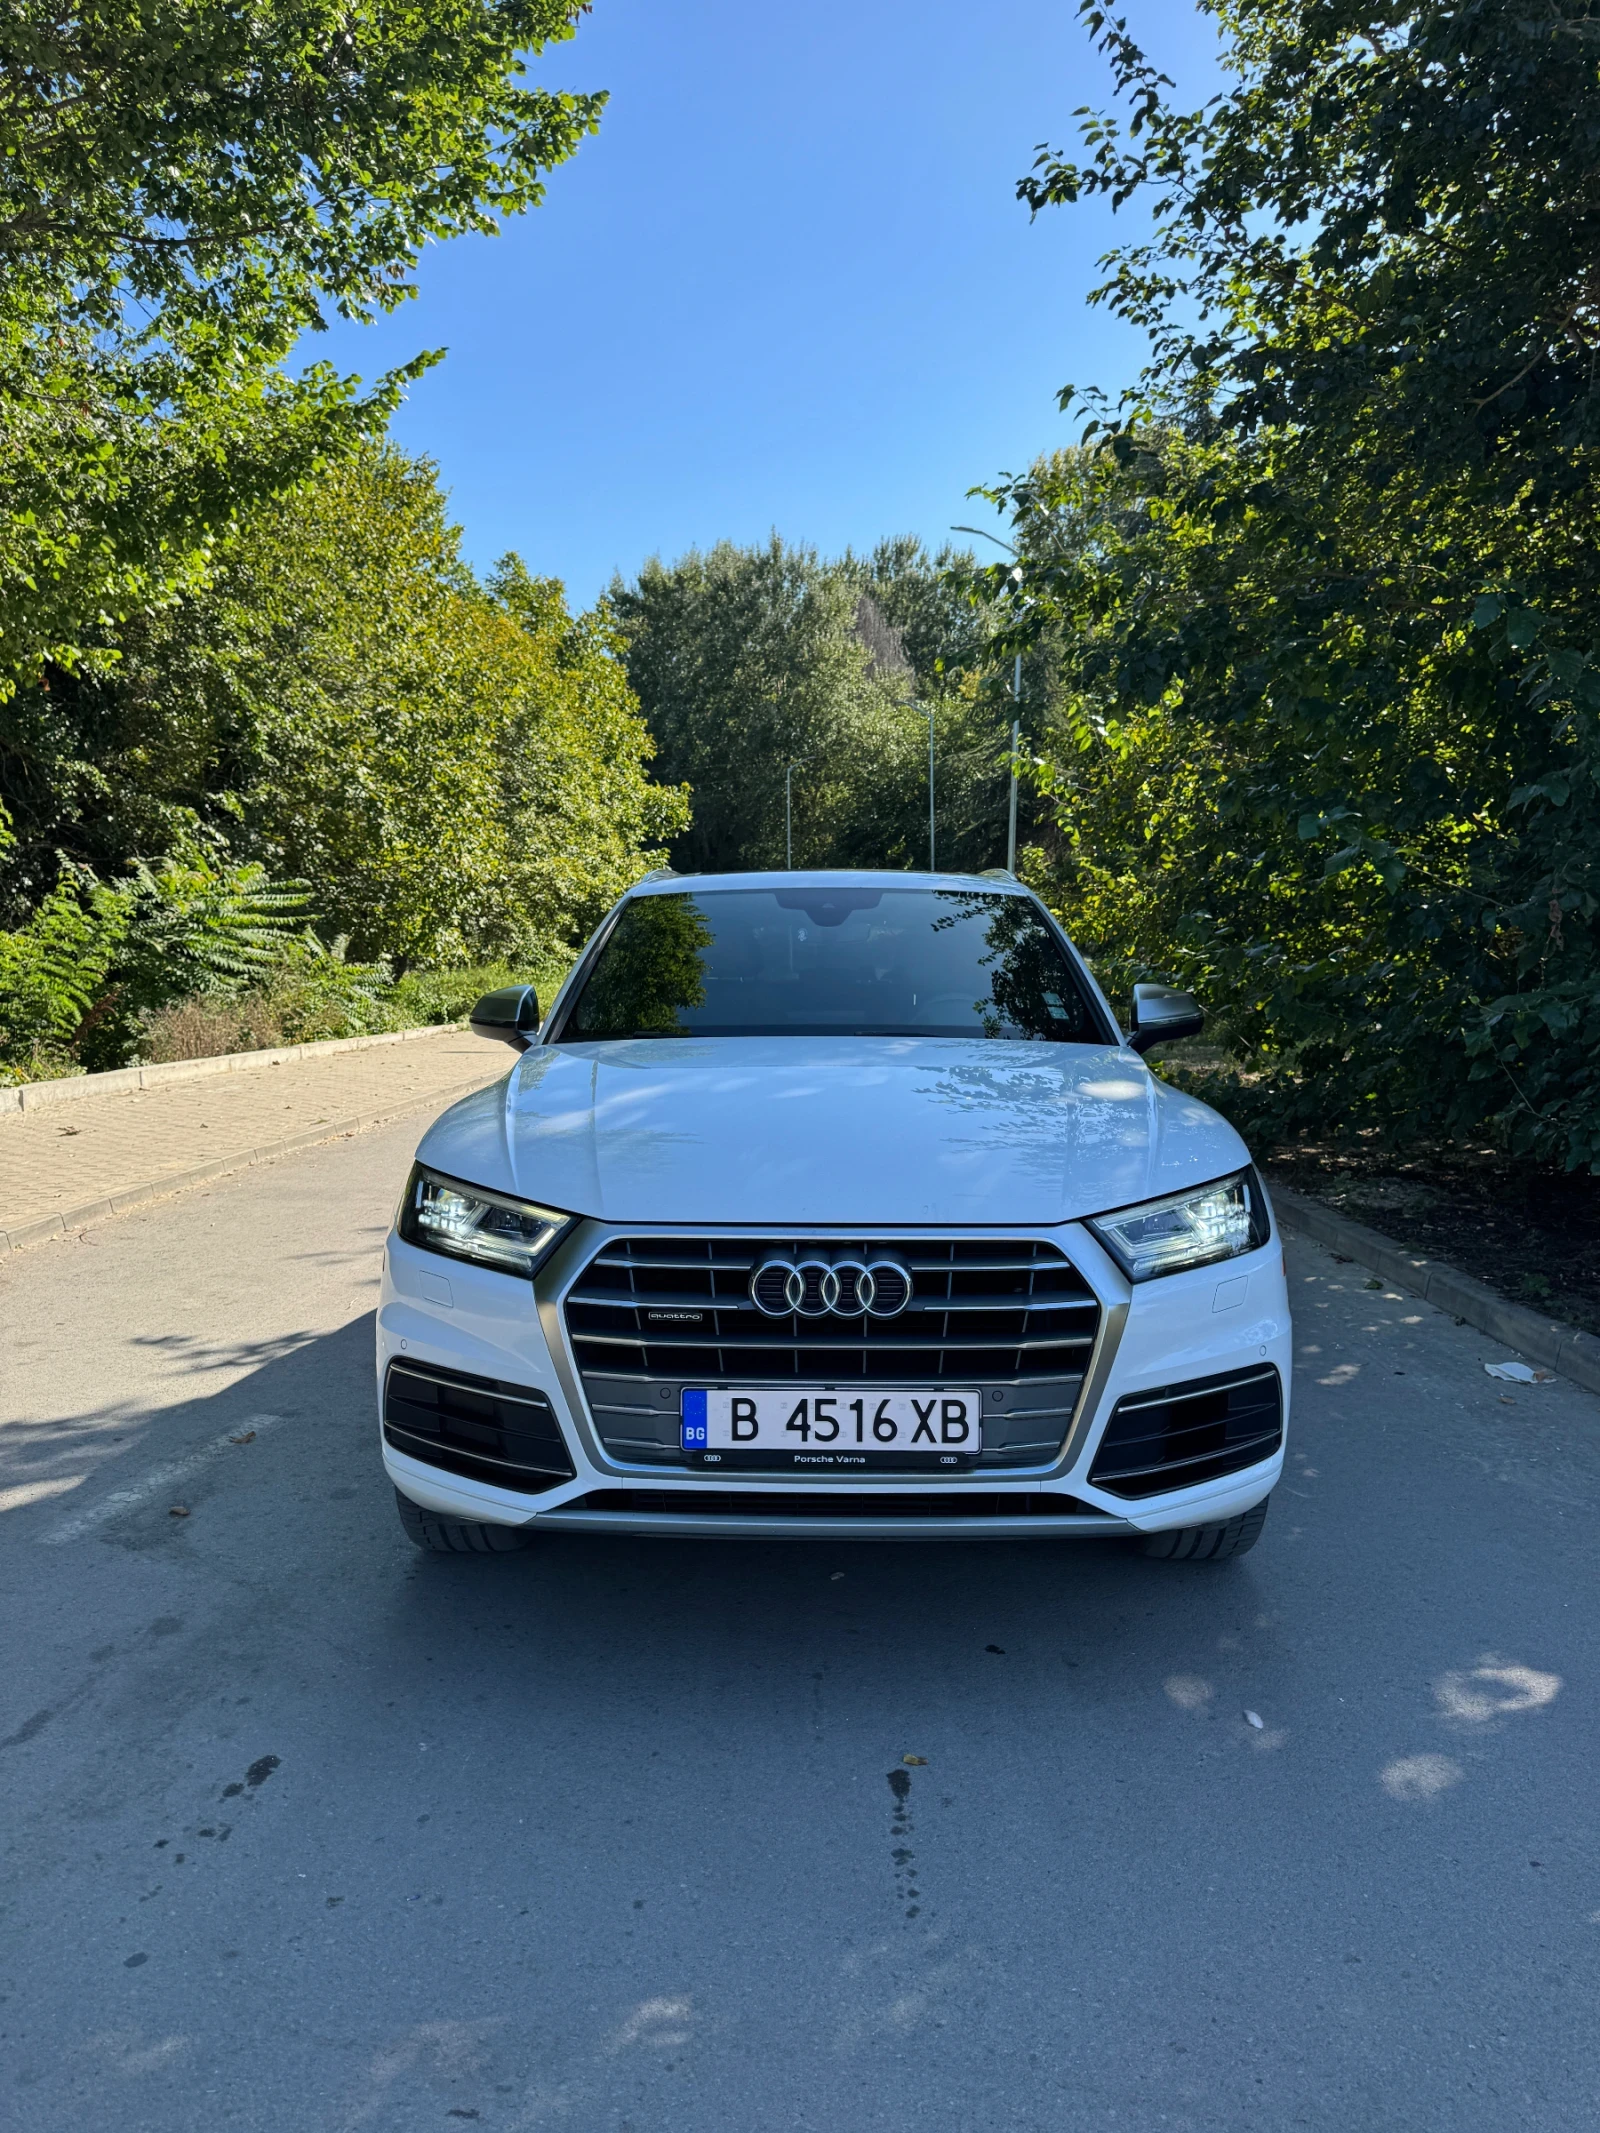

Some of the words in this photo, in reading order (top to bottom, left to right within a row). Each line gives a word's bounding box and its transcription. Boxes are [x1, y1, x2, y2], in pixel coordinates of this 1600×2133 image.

[731, 1397, 759, 1441] B
[785, 1398, 898, 1443] 4516
[910, 1399, 970, 1443] XB
[685, 1426, 705, 1441] BG
[794, 1455, 834, 1463] Porsche
[835, 1455, 866, 1463] Varna
